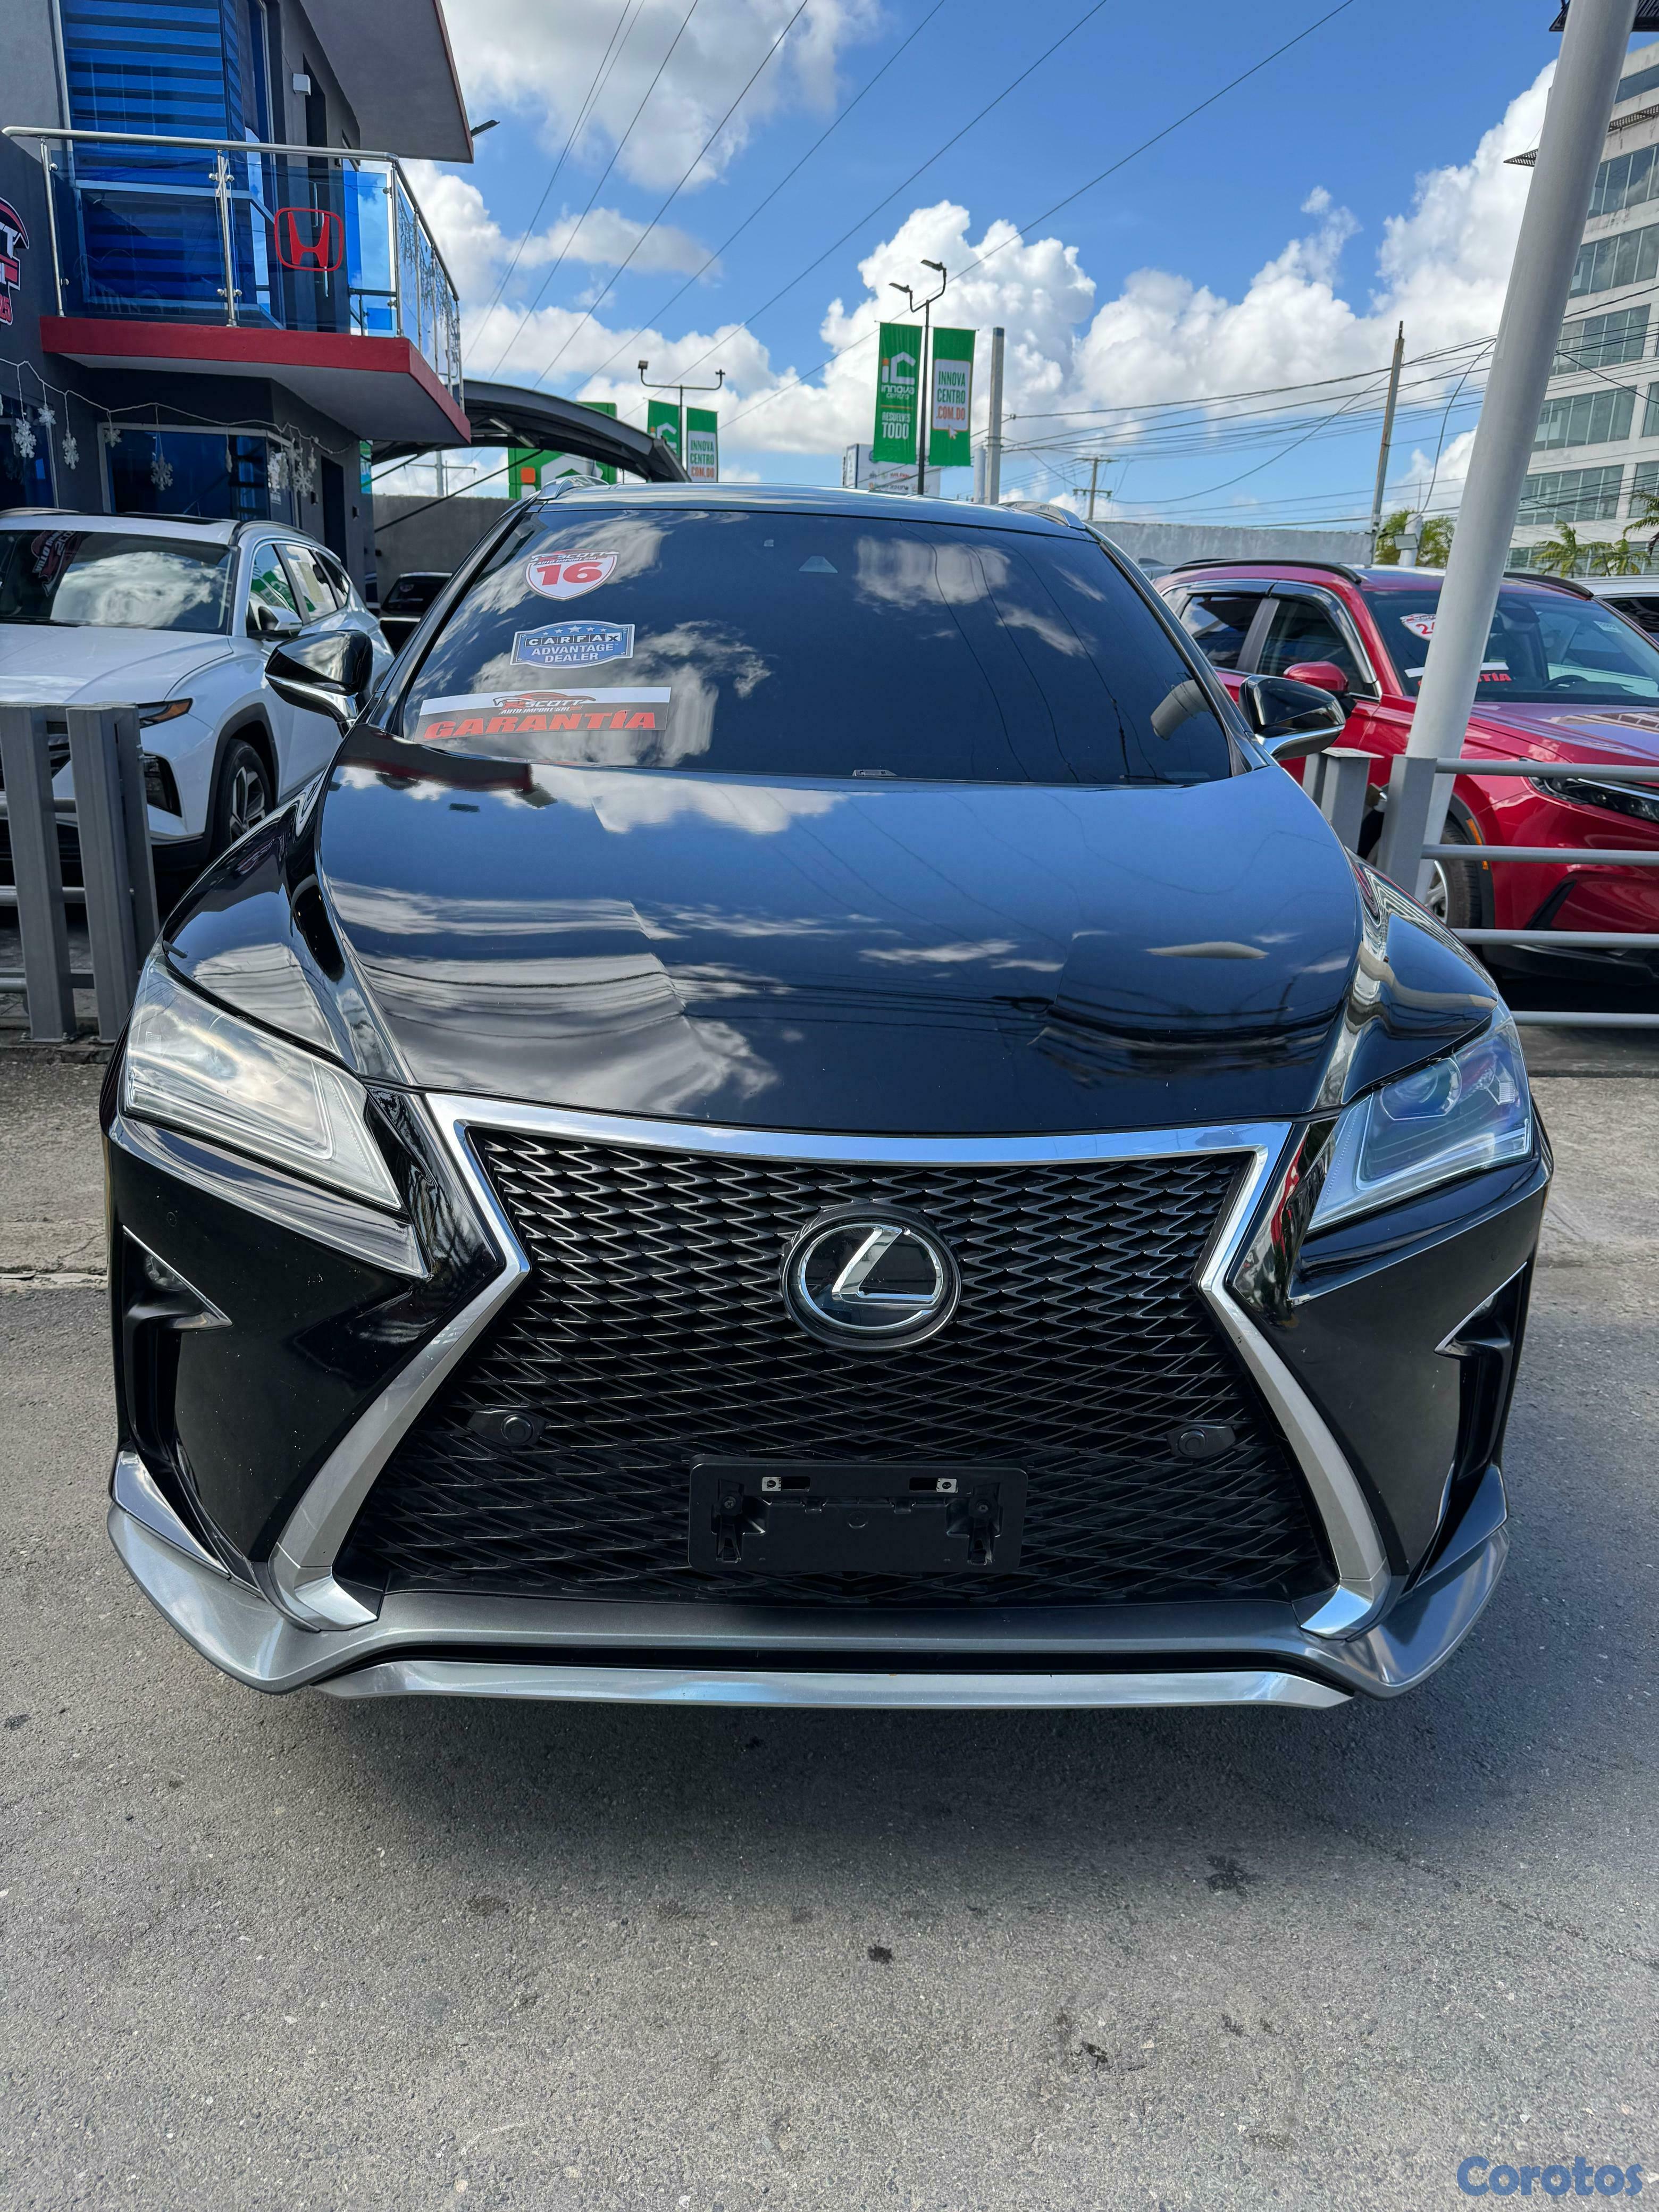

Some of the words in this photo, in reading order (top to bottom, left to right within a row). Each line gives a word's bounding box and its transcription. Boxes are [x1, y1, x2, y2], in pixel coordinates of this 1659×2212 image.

[939, 371, 965, 387] INNOVA
[881, 384, 915, 395] innova
[937, 388, 966, 404] CENTRO
[882, 422, 909, 440] TODO
[691, 440, 714, 452] INNOVA
[690, 453, 715, 465] CENTRO
[537, 562, 602, 586] 16
[528, 633, 619, 646] CARFAX
[544, 653, 598, 663] DEALER
[424, 709, 656, 740] GARANTÍA
